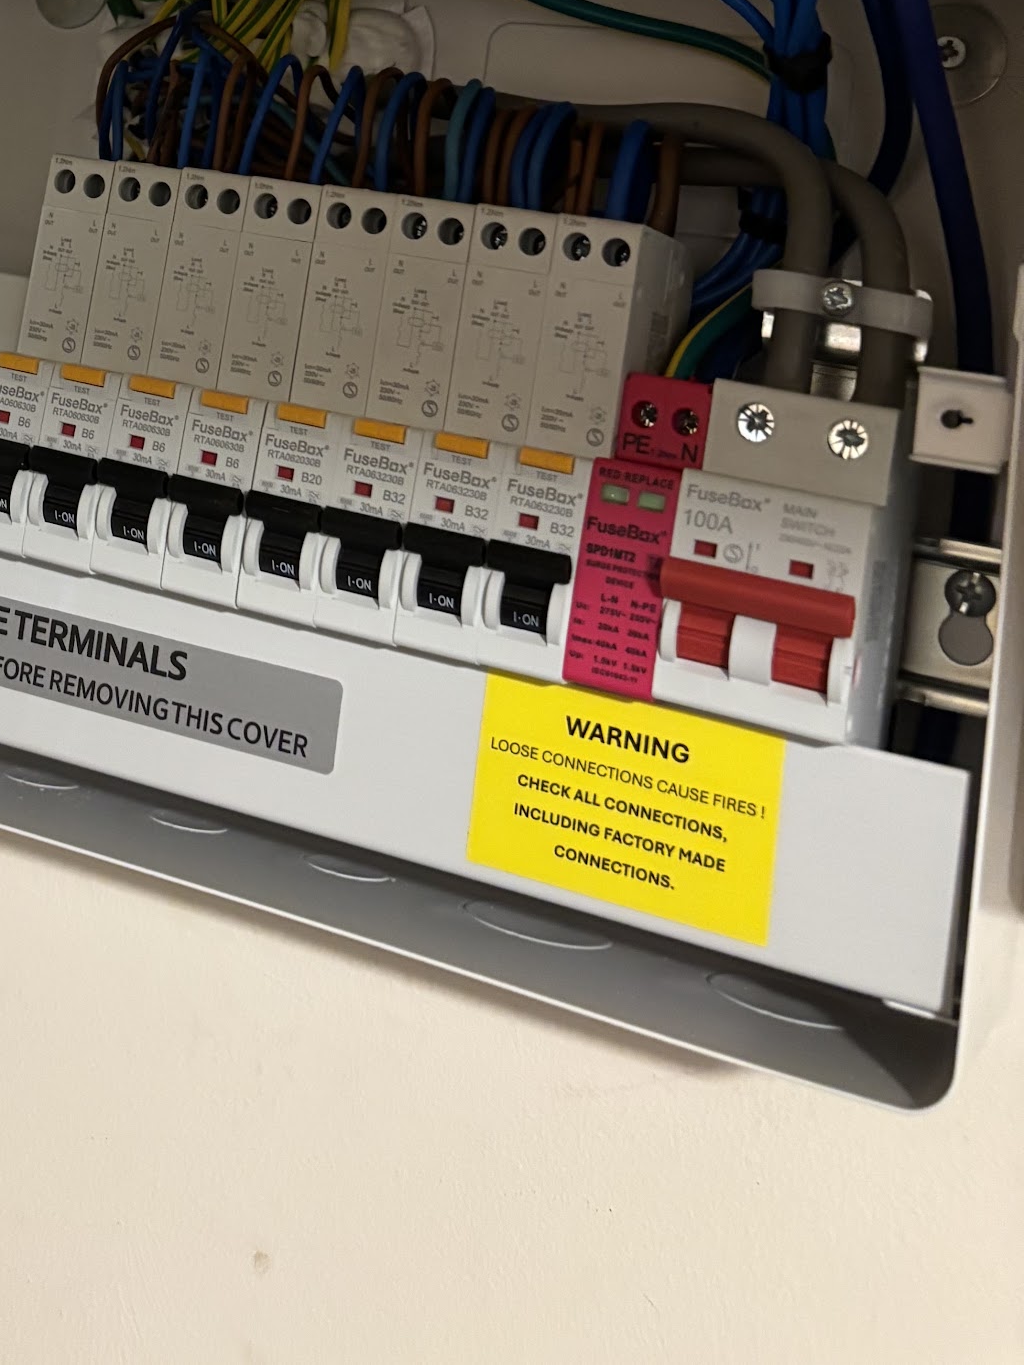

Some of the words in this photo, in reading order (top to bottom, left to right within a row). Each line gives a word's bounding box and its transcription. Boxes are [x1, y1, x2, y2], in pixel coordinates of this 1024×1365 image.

[18, 417, 30, 428] B6
[0, 428, 17, 440] 30mA
[82, 428, 94, 439] B6
[63, 440, 82, 452] 30mA
[152, 441, 165, 452] B6
[623, 433, 651, 455] PE
[132, 453, 152, 465] 30mA
[681, 443, 698, 463] N
[226, 457, 239, 468] B6
[302, 472, 322, 485] B20
[383, 490, 406, 505] B32
[465, 505, 489, 520] B32
[683, 509, 733, 533] 100A
[550, 522, 575, 538] B32
[16, 611, 188, 681] TERMINALS
[49, 670, 170, 720] REMOVING
[171, 702, 224, 735] THIS
[227, 718, 308, 757] COVER
[565, 716, 690, 763] WARNING
[490, 737, 538, 760] LOOSE
[542, 750, 653, 789] CONNECTIONS
[656, 779, 708, 804] CAUSE
[713, 794, 756, 816] FIRES
[517, 774, 570, 798] CHECK
[574, 788, 600, 807] ALL
[604, 797, 728, 842] CONNECTIONS,
[514, 802, 600, 837] INCLUDING
[604, 827, 675, 857] FACTORY
[678, 848, 726, 872] MADE
[554, 845, 675, 890] CONNECTIONS.
